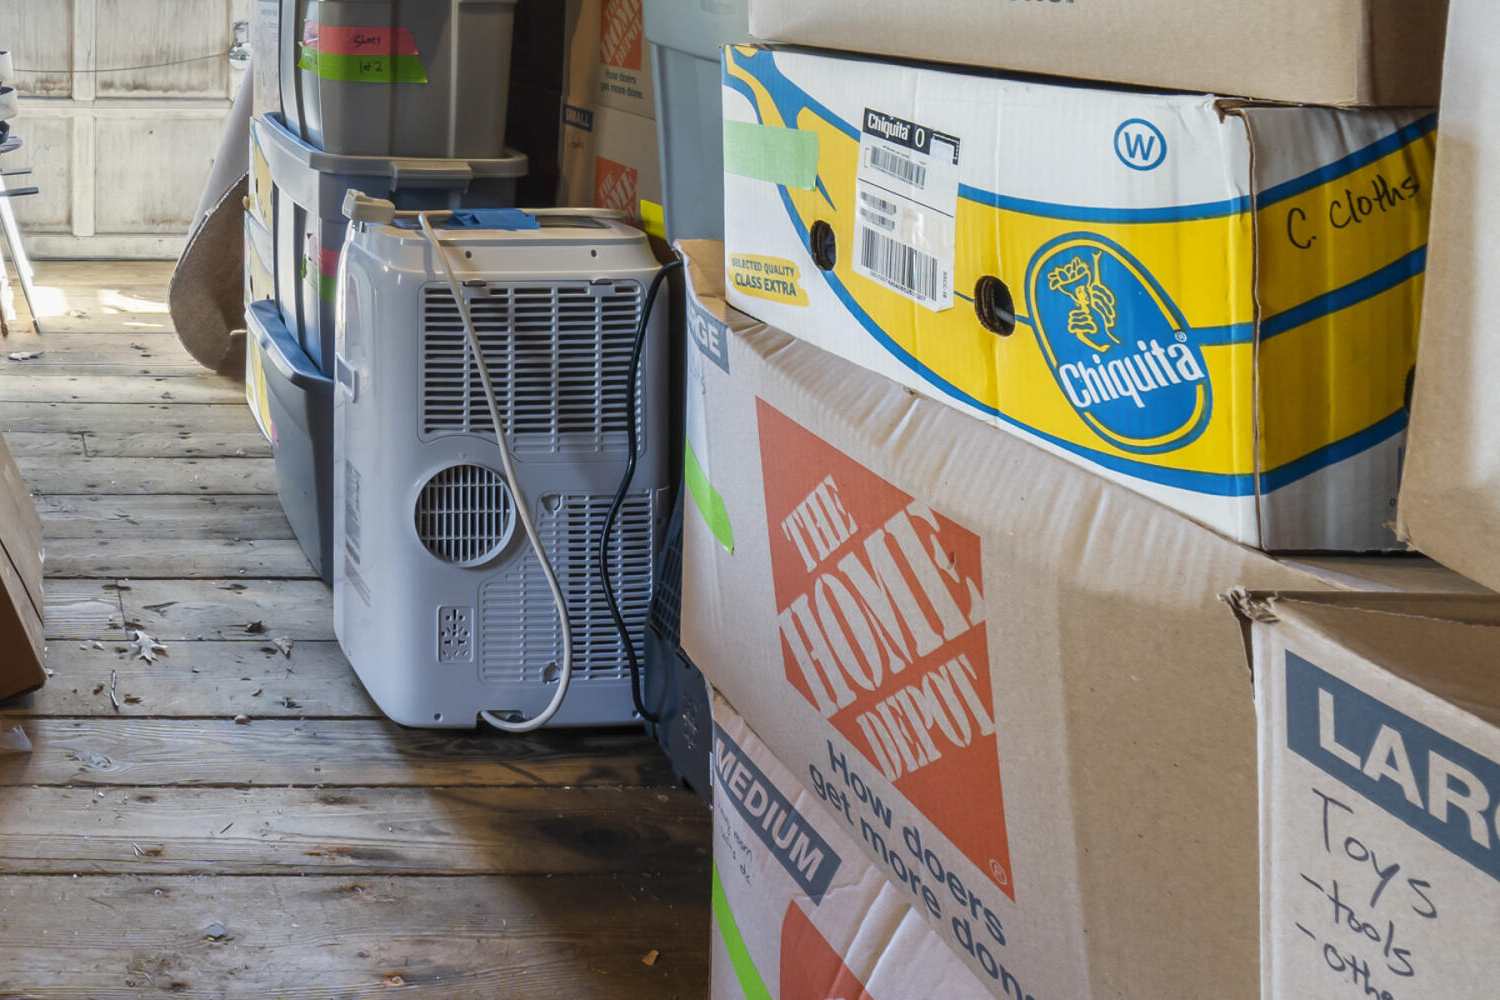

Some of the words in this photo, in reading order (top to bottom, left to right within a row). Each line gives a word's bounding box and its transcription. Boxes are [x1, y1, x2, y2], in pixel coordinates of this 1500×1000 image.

[615, 13, 643, 67] DEPOT
[867, 112, 910, 142] Chiquita
[1123, 131, 1155, 161] W
[732, 257, 763, 272] SELECTED
[763, 263, 795, 278] QUALITY
[735, 273, 762, 290] CLASS
[764, 278, 797, 297] EXTRA
[1059, 339, 1204, 409] Chiquita
[780, 473, 859, 573] THE
[777, 500, 986, 721] HOME
[855, 653, 996, 782] DEPOT
[1318, 687, 1500, 851] LAR
[716, 737, 824, 882] MEDIUM
[827, 739, 892, 830] How
[903, 826, 1006, 947] doers
[1312, 787, 1438, 919] Toys
[809, 763, 854, 827] get
[860, 817, 941, 920] more
[952, 916, 1036, 1000] don
